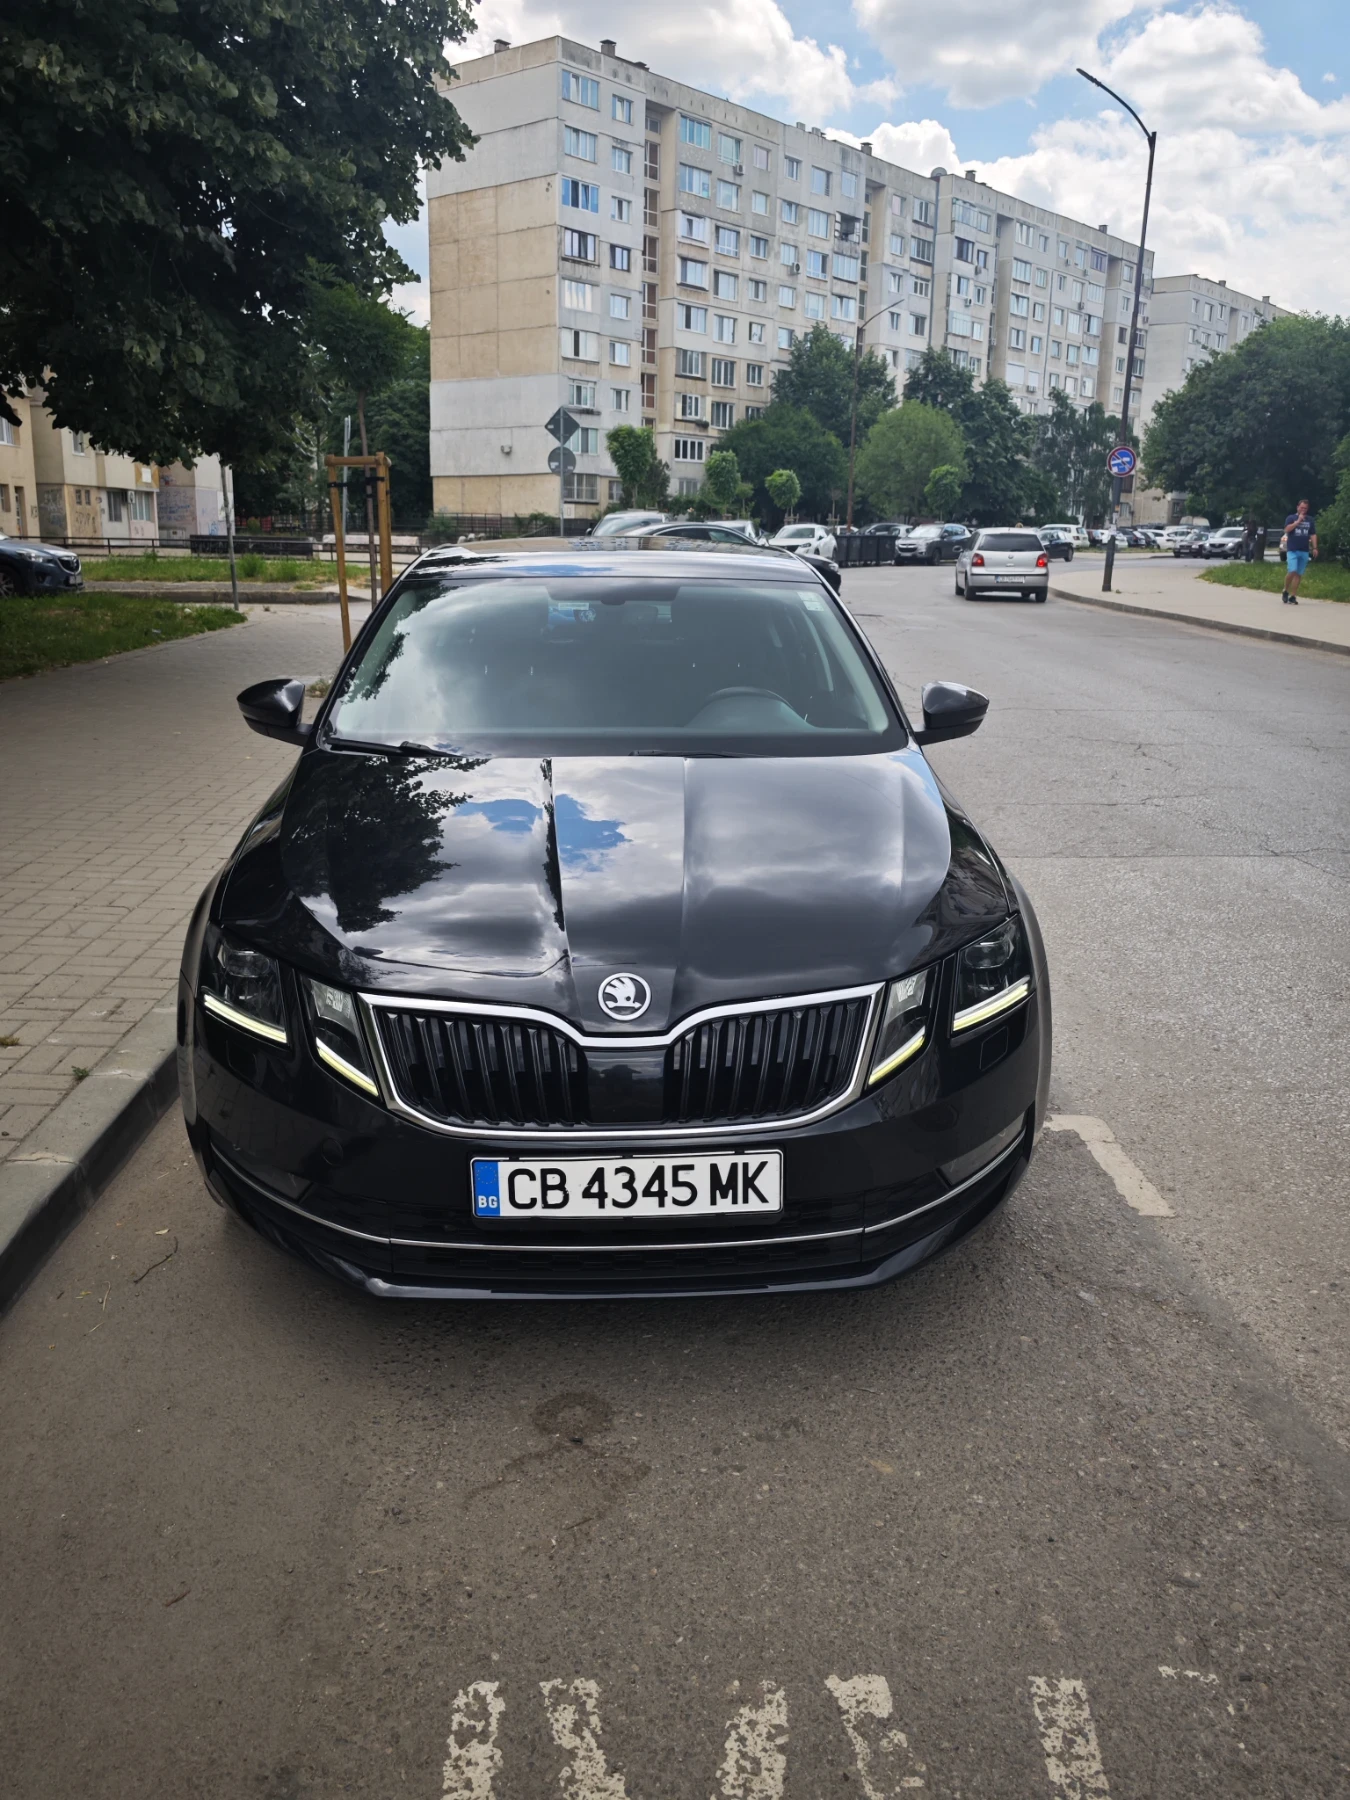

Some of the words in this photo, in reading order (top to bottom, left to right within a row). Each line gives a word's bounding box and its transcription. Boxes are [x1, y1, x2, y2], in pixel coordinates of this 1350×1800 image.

[508, 1168, 569, 1209] CB
[582, 1164, 698, 1208] 4345
[709, 1161, 770, 1206] MK
[478, 1195, 498, 1208] BG
